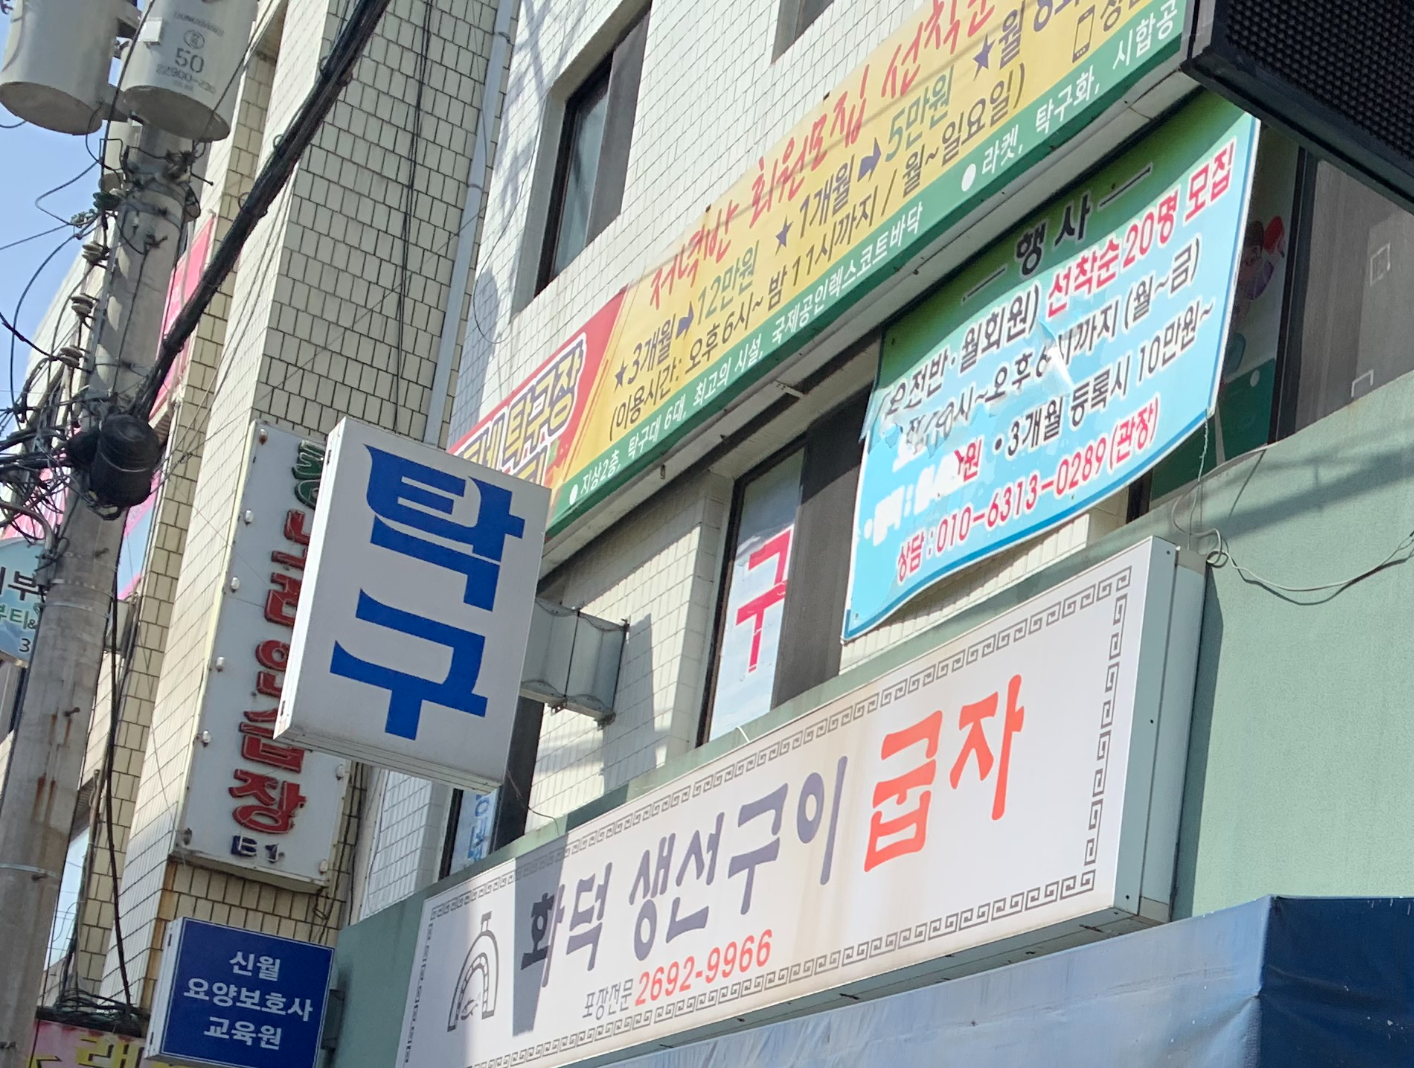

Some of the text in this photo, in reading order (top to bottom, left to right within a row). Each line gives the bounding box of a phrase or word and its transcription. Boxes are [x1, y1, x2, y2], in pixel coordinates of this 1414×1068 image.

[175, 47, 204, 73] 50
[749, 64, 870, 228] 회원모집
[1185, 141, 1235, 222] 모집
[627, 313, 677, 385] 3개월
[698, 240, 759, 325] 12만원
[799, 154, 856, 238] 1개월
[885, 65, 954, 162] 5만원
[627, 413, 661, 460] 탁구대
[692, 361, 730, 407] 최고의
[1070, 355, 1131, 427] 등록시
[330, 443, 525, 741] 탁구
[521, 673, 1025, 988] 화덕 생선구이 굽자
[183, 977, 313, 1022] 요양보호사
[229, 951, 281, 981] 신월
[582, 929, 773, 1021] 포장전문 2692-9966
[204, 1017, 282, 1050] 교육원
